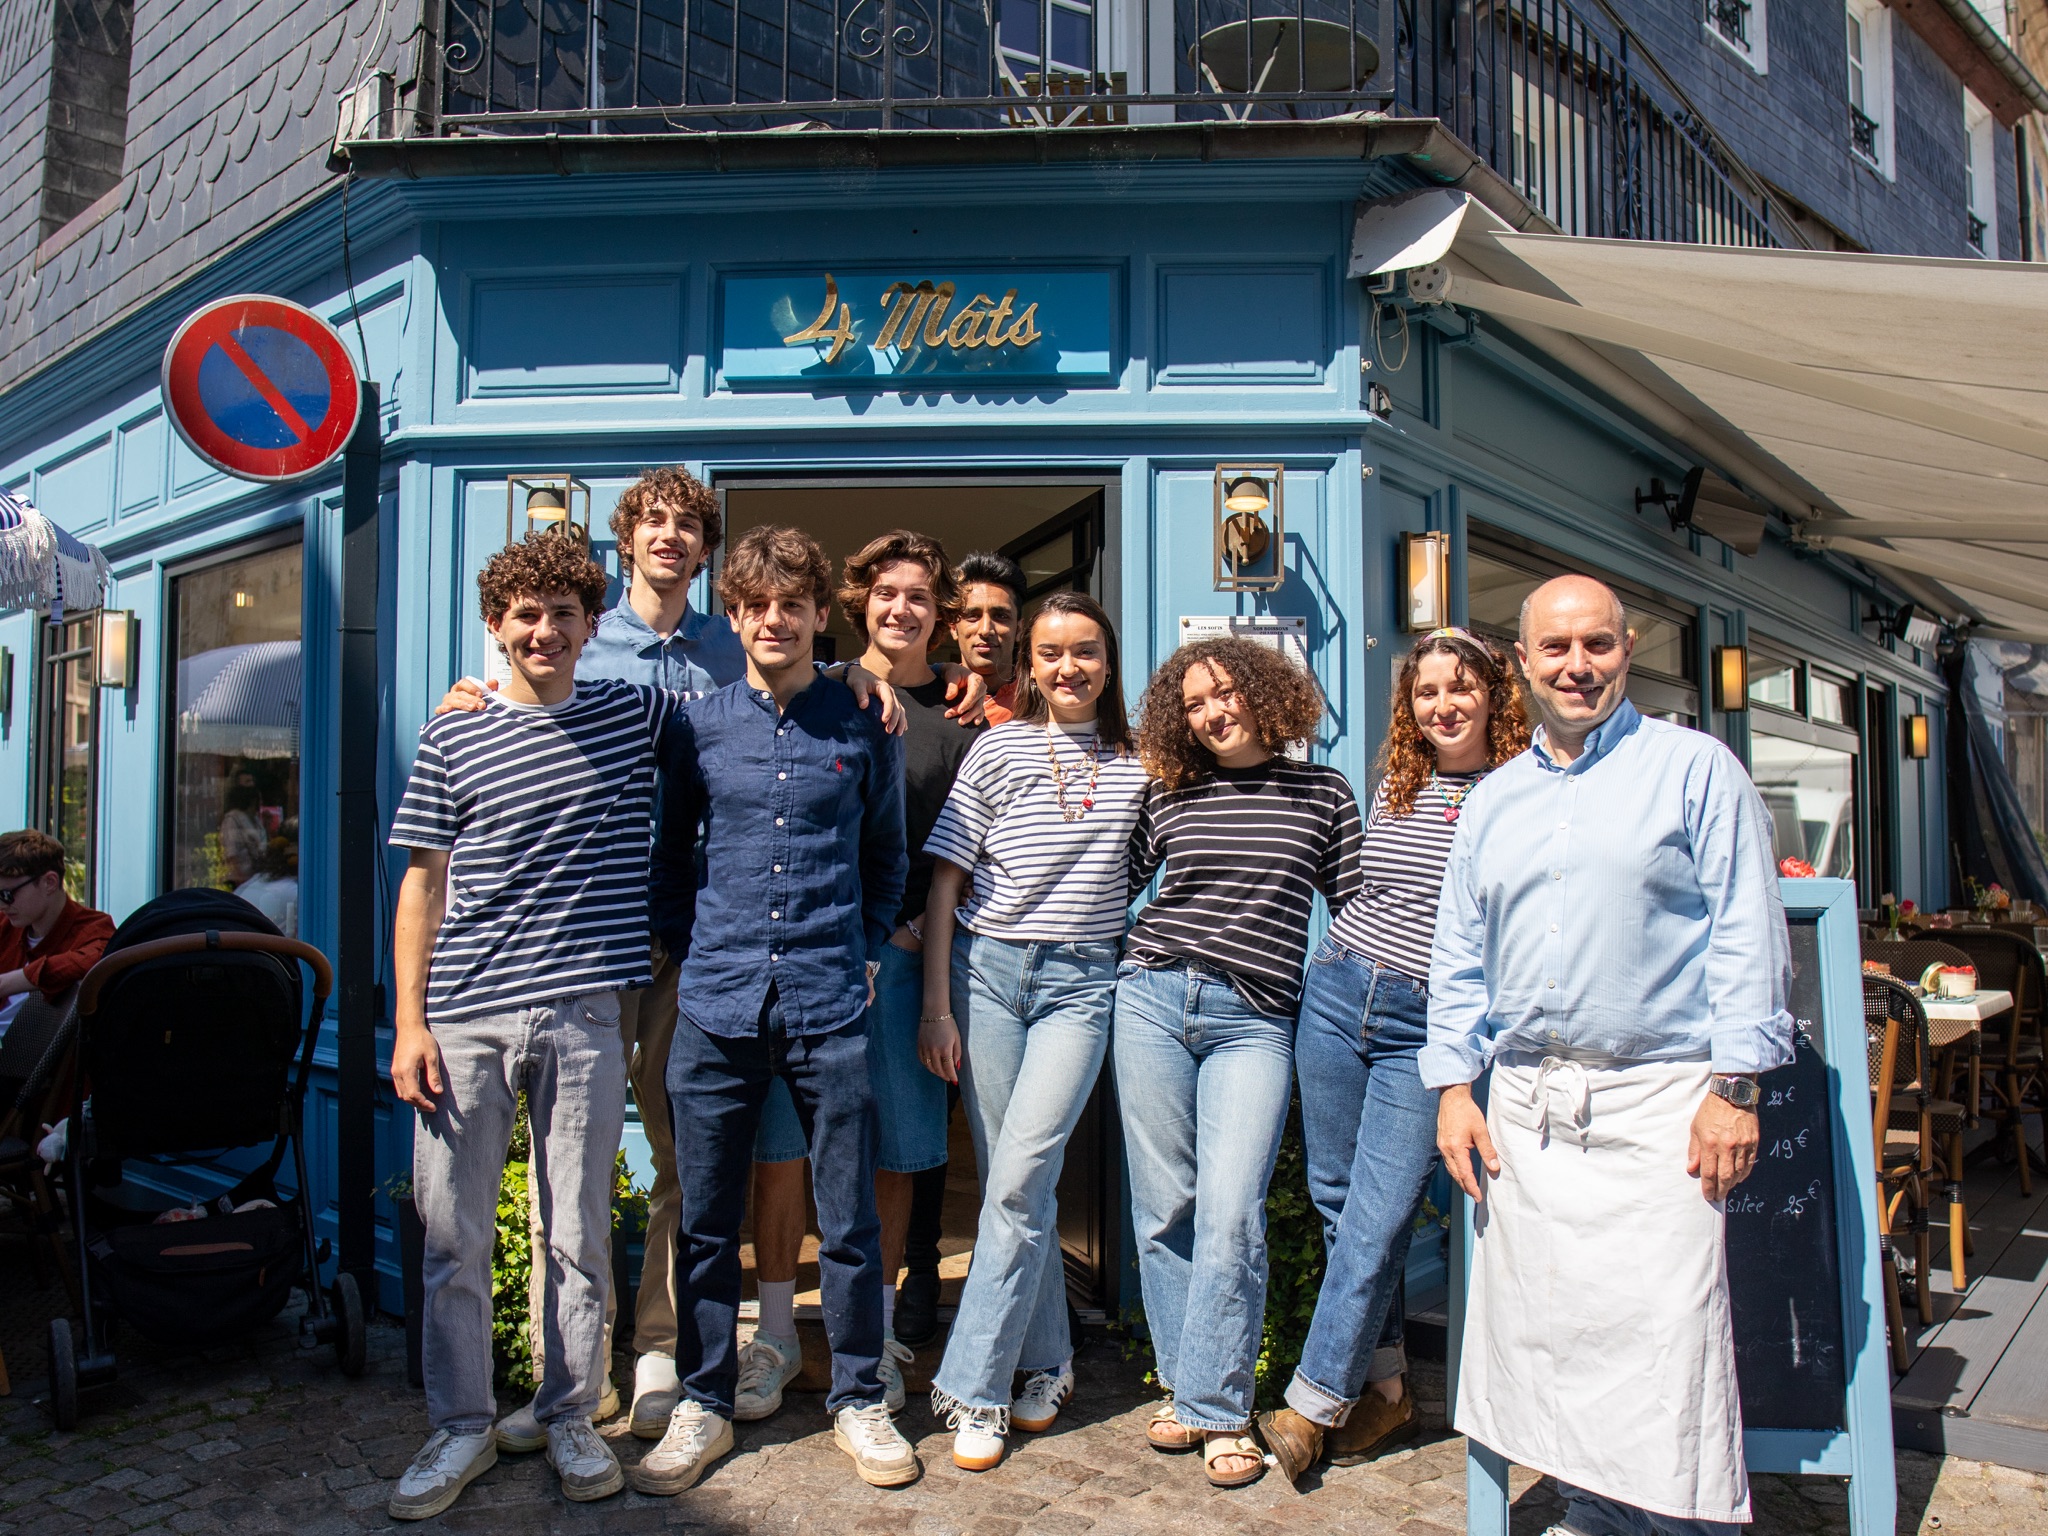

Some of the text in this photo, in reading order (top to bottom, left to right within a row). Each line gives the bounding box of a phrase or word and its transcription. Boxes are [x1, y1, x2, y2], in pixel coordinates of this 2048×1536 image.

[783, 273, 1042, 364] 4 Mâts
[1726, 1190, 1765, 1214] sitée
